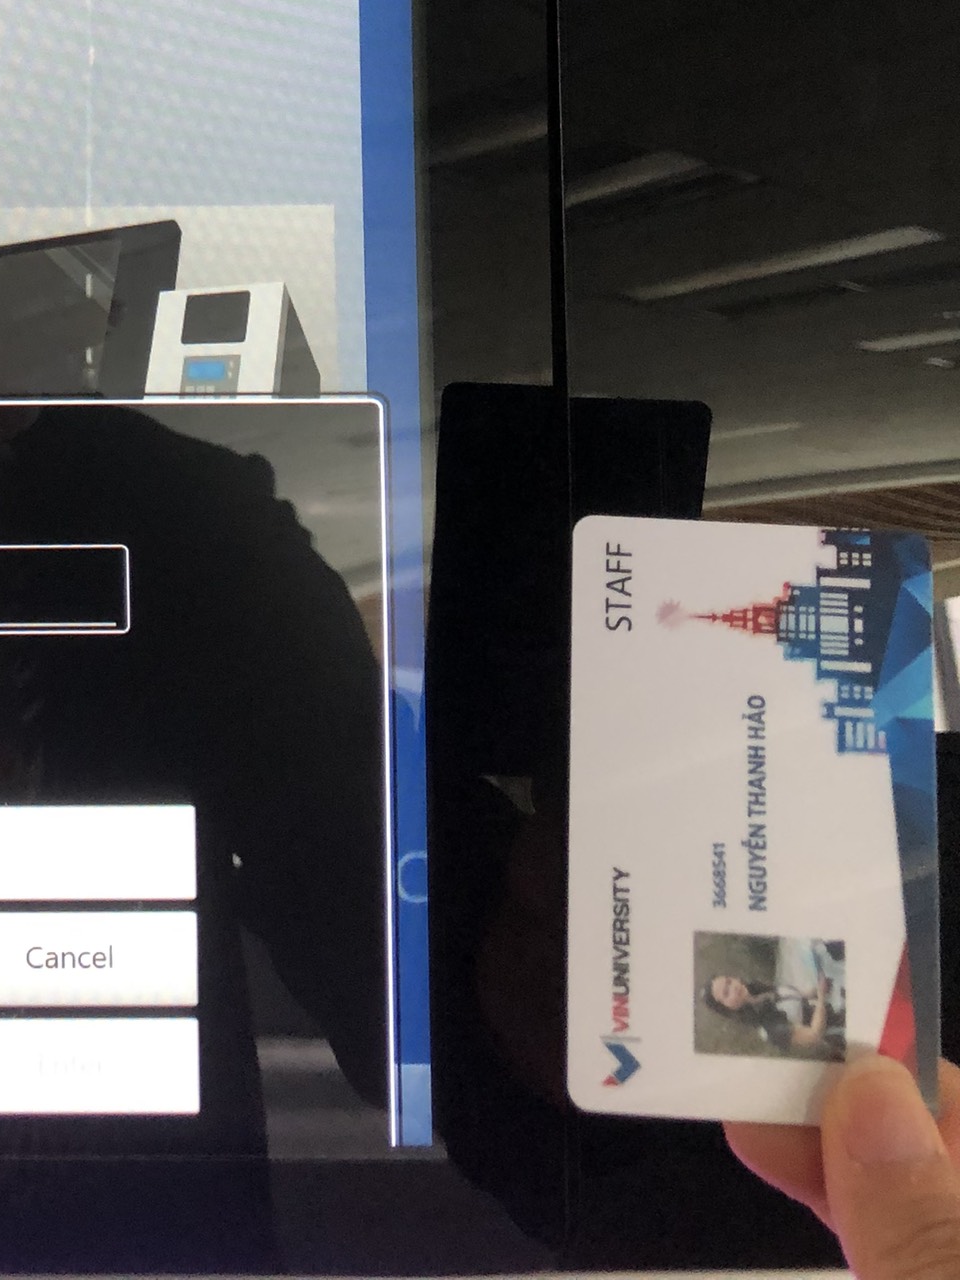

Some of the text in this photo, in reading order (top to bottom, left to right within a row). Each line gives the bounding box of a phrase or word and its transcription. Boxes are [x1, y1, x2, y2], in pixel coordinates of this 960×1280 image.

[606, 541, 634, 632] STAFF
[741, 694, 767, 740] HẢO
[747, 745, 767, 818] THANH
[24, 944, 115, 971] Cancel
